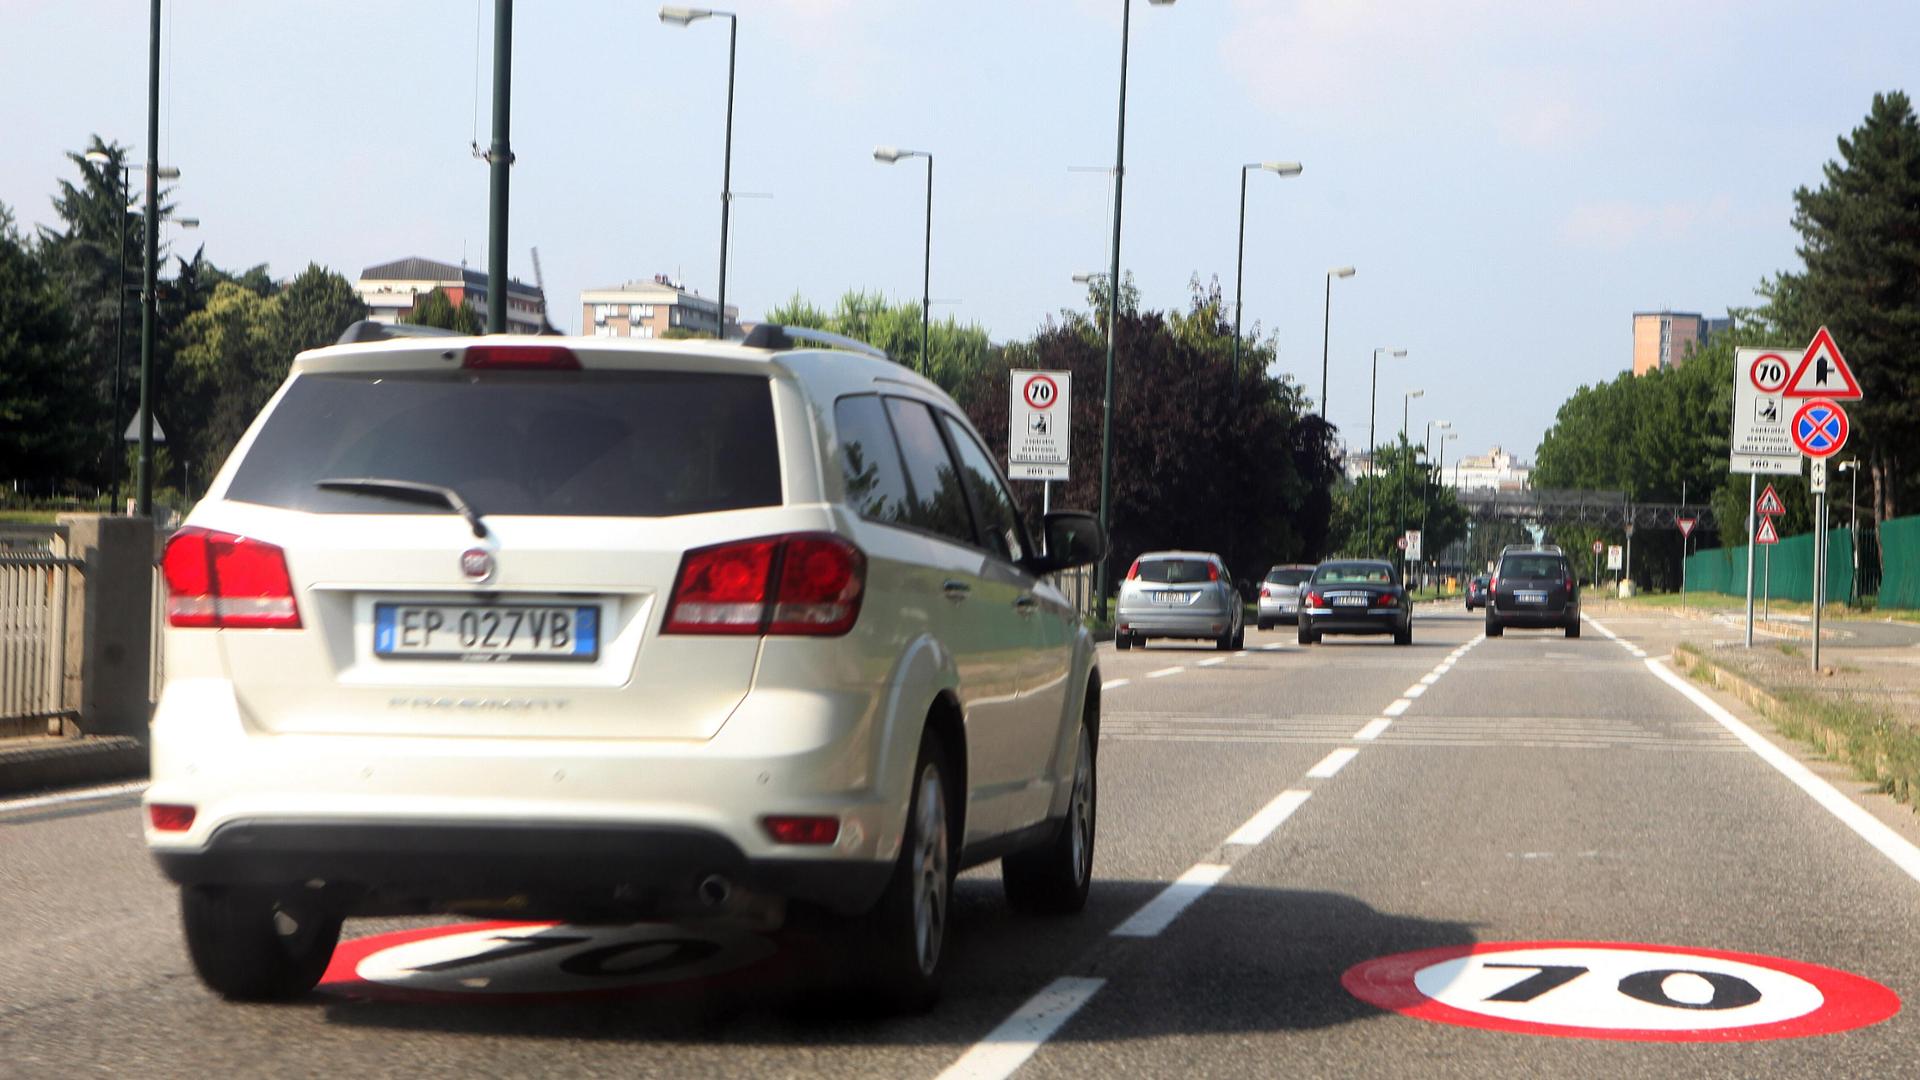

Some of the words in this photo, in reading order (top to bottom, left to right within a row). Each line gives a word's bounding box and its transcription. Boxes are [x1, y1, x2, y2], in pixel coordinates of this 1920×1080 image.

[1032, 384, 1050, 400] 70
[1760, 365, 1781, 382] 70
[402, 610, 443, 648] EP
[459, 610, 571, 649] 027VB
[404, 935, 723, 976] 70
[1479, 963, 1763, 1011] 70
